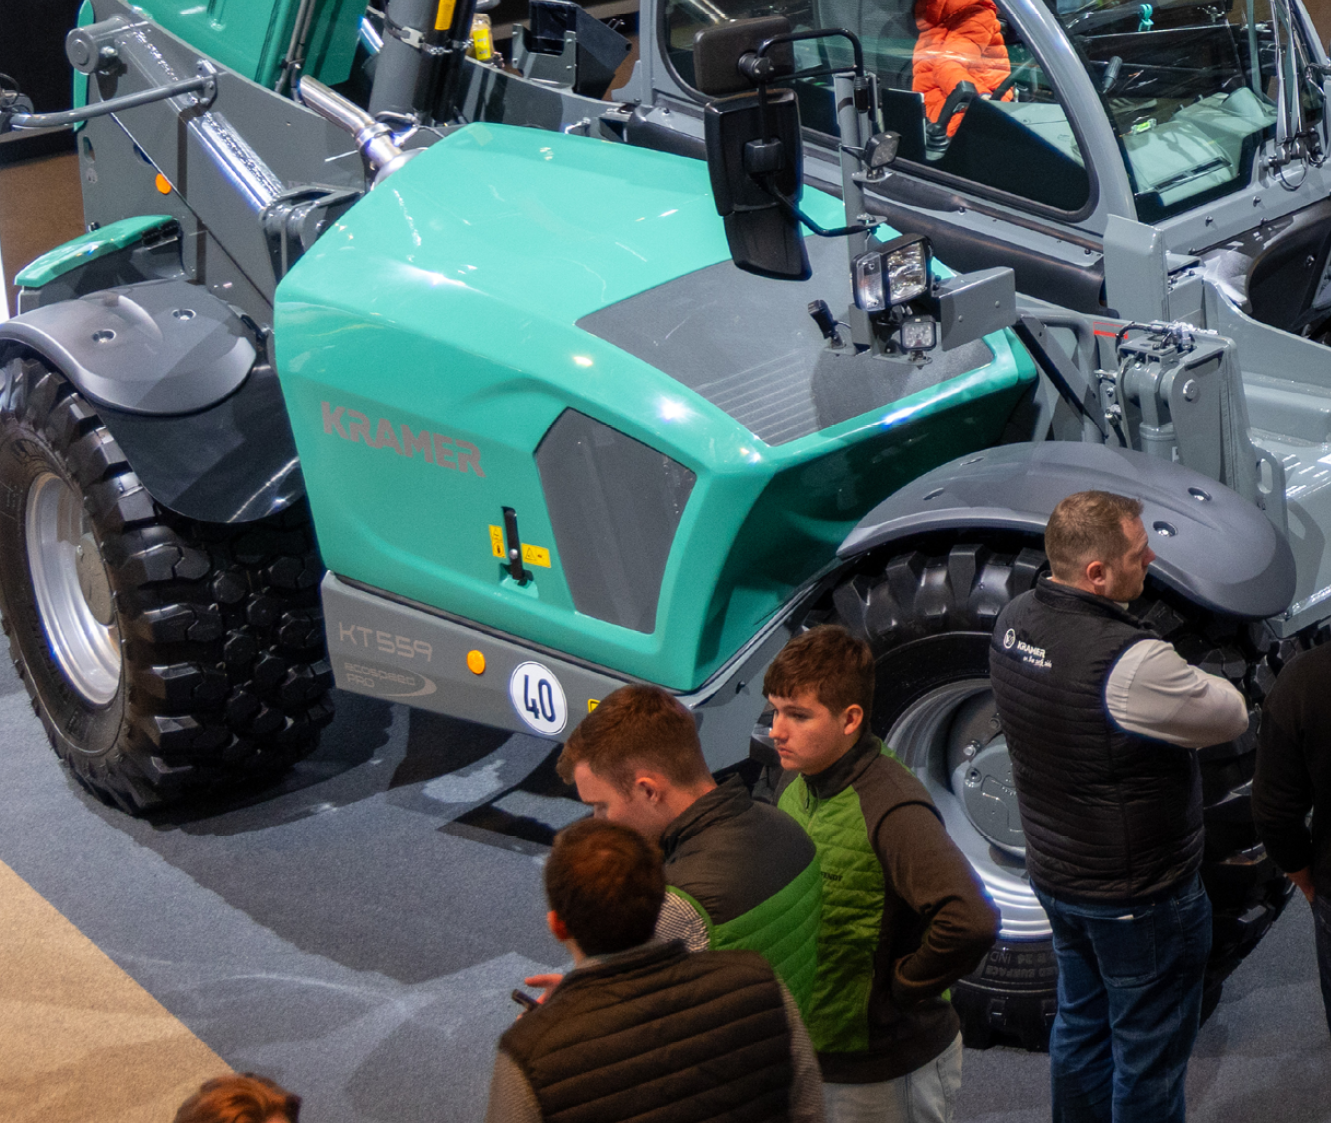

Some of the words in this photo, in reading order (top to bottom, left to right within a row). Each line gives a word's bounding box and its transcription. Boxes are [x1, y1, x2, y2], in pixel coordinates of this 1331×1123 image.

[320, 400, 487, 478] KRAMER
[1017, 640, 1046, 659] KRAMER
[523, 673, 557, 723] 40
